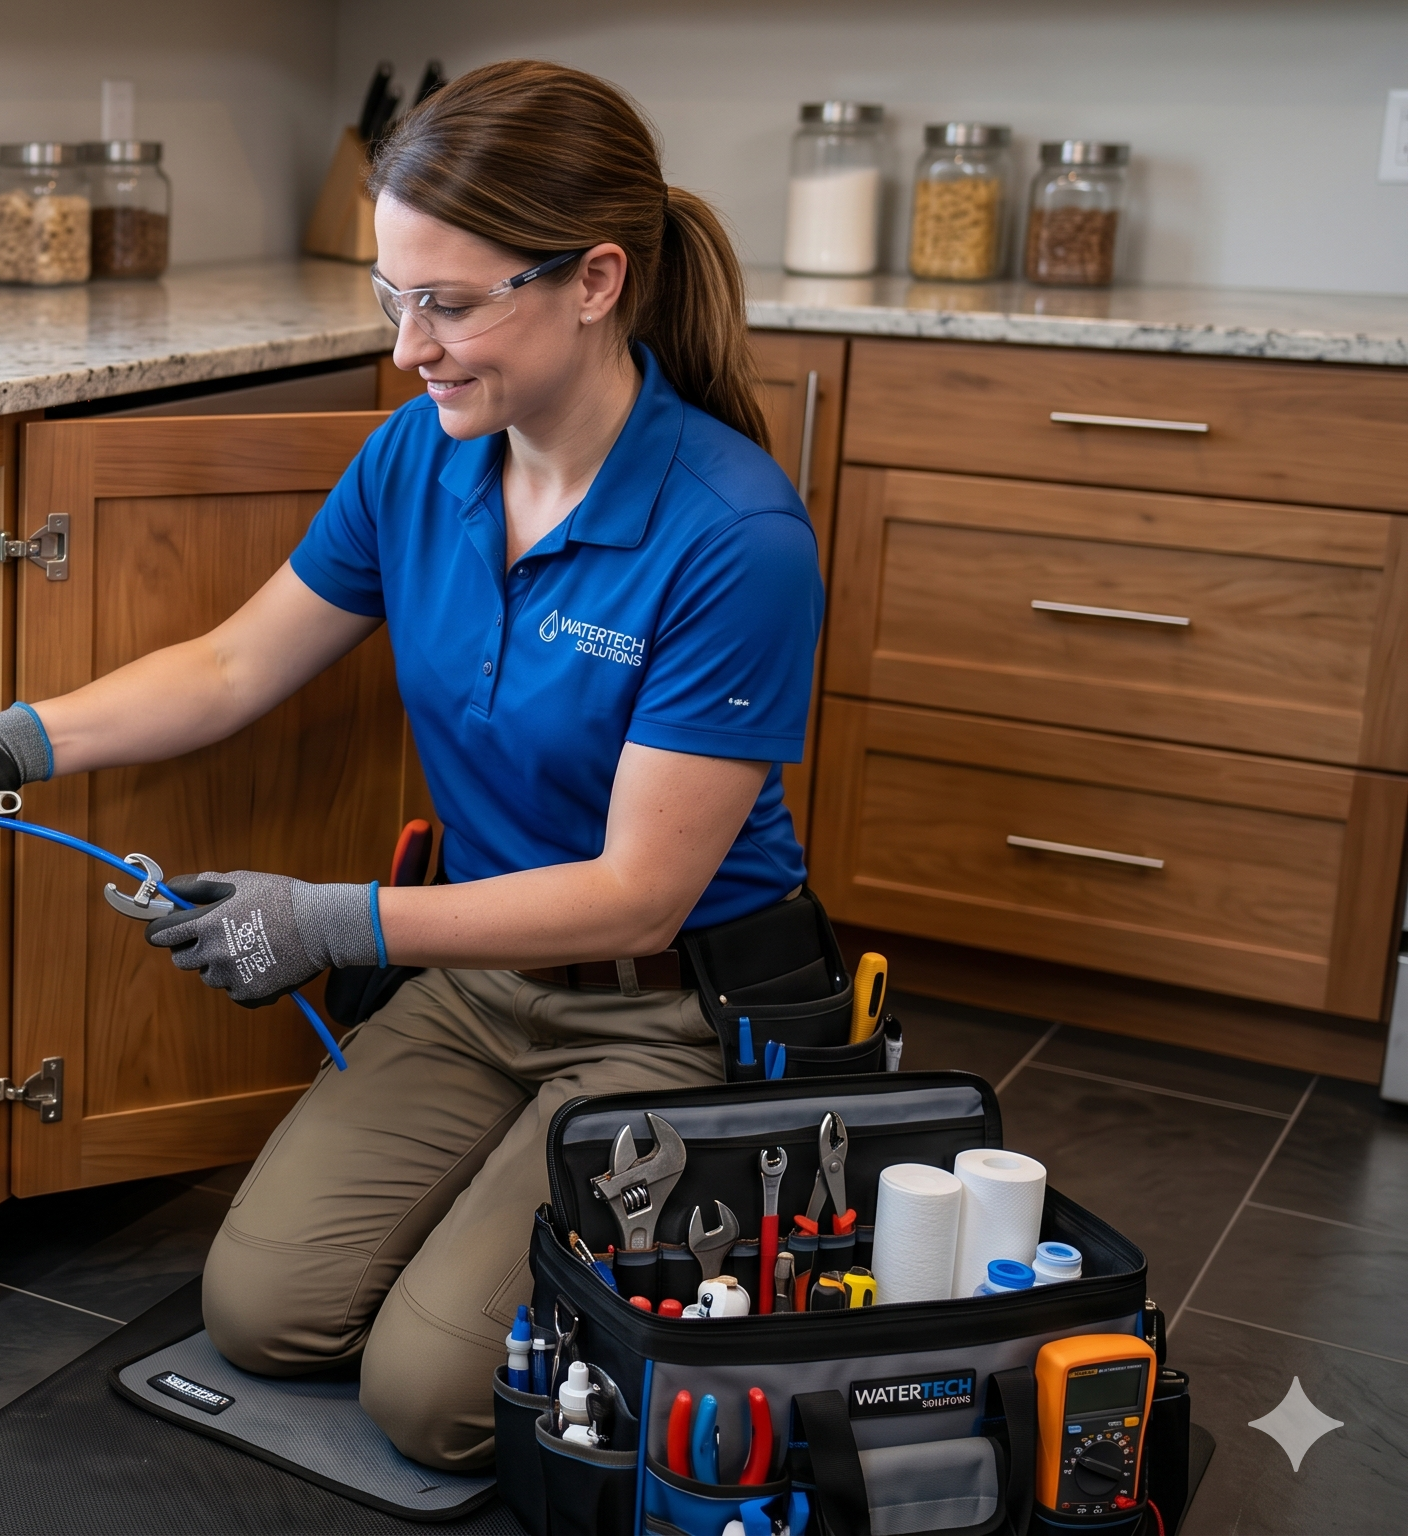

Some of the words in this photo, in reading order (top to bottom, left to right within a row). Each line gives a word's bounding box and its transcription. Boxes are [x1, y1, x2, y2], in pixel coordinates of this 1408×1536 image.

[561, 616, 645, 654] WATERTECH
[575, 640, 642, 666] SOLUTIONS
[855, 1377, 972, 1406] WATERTECH
